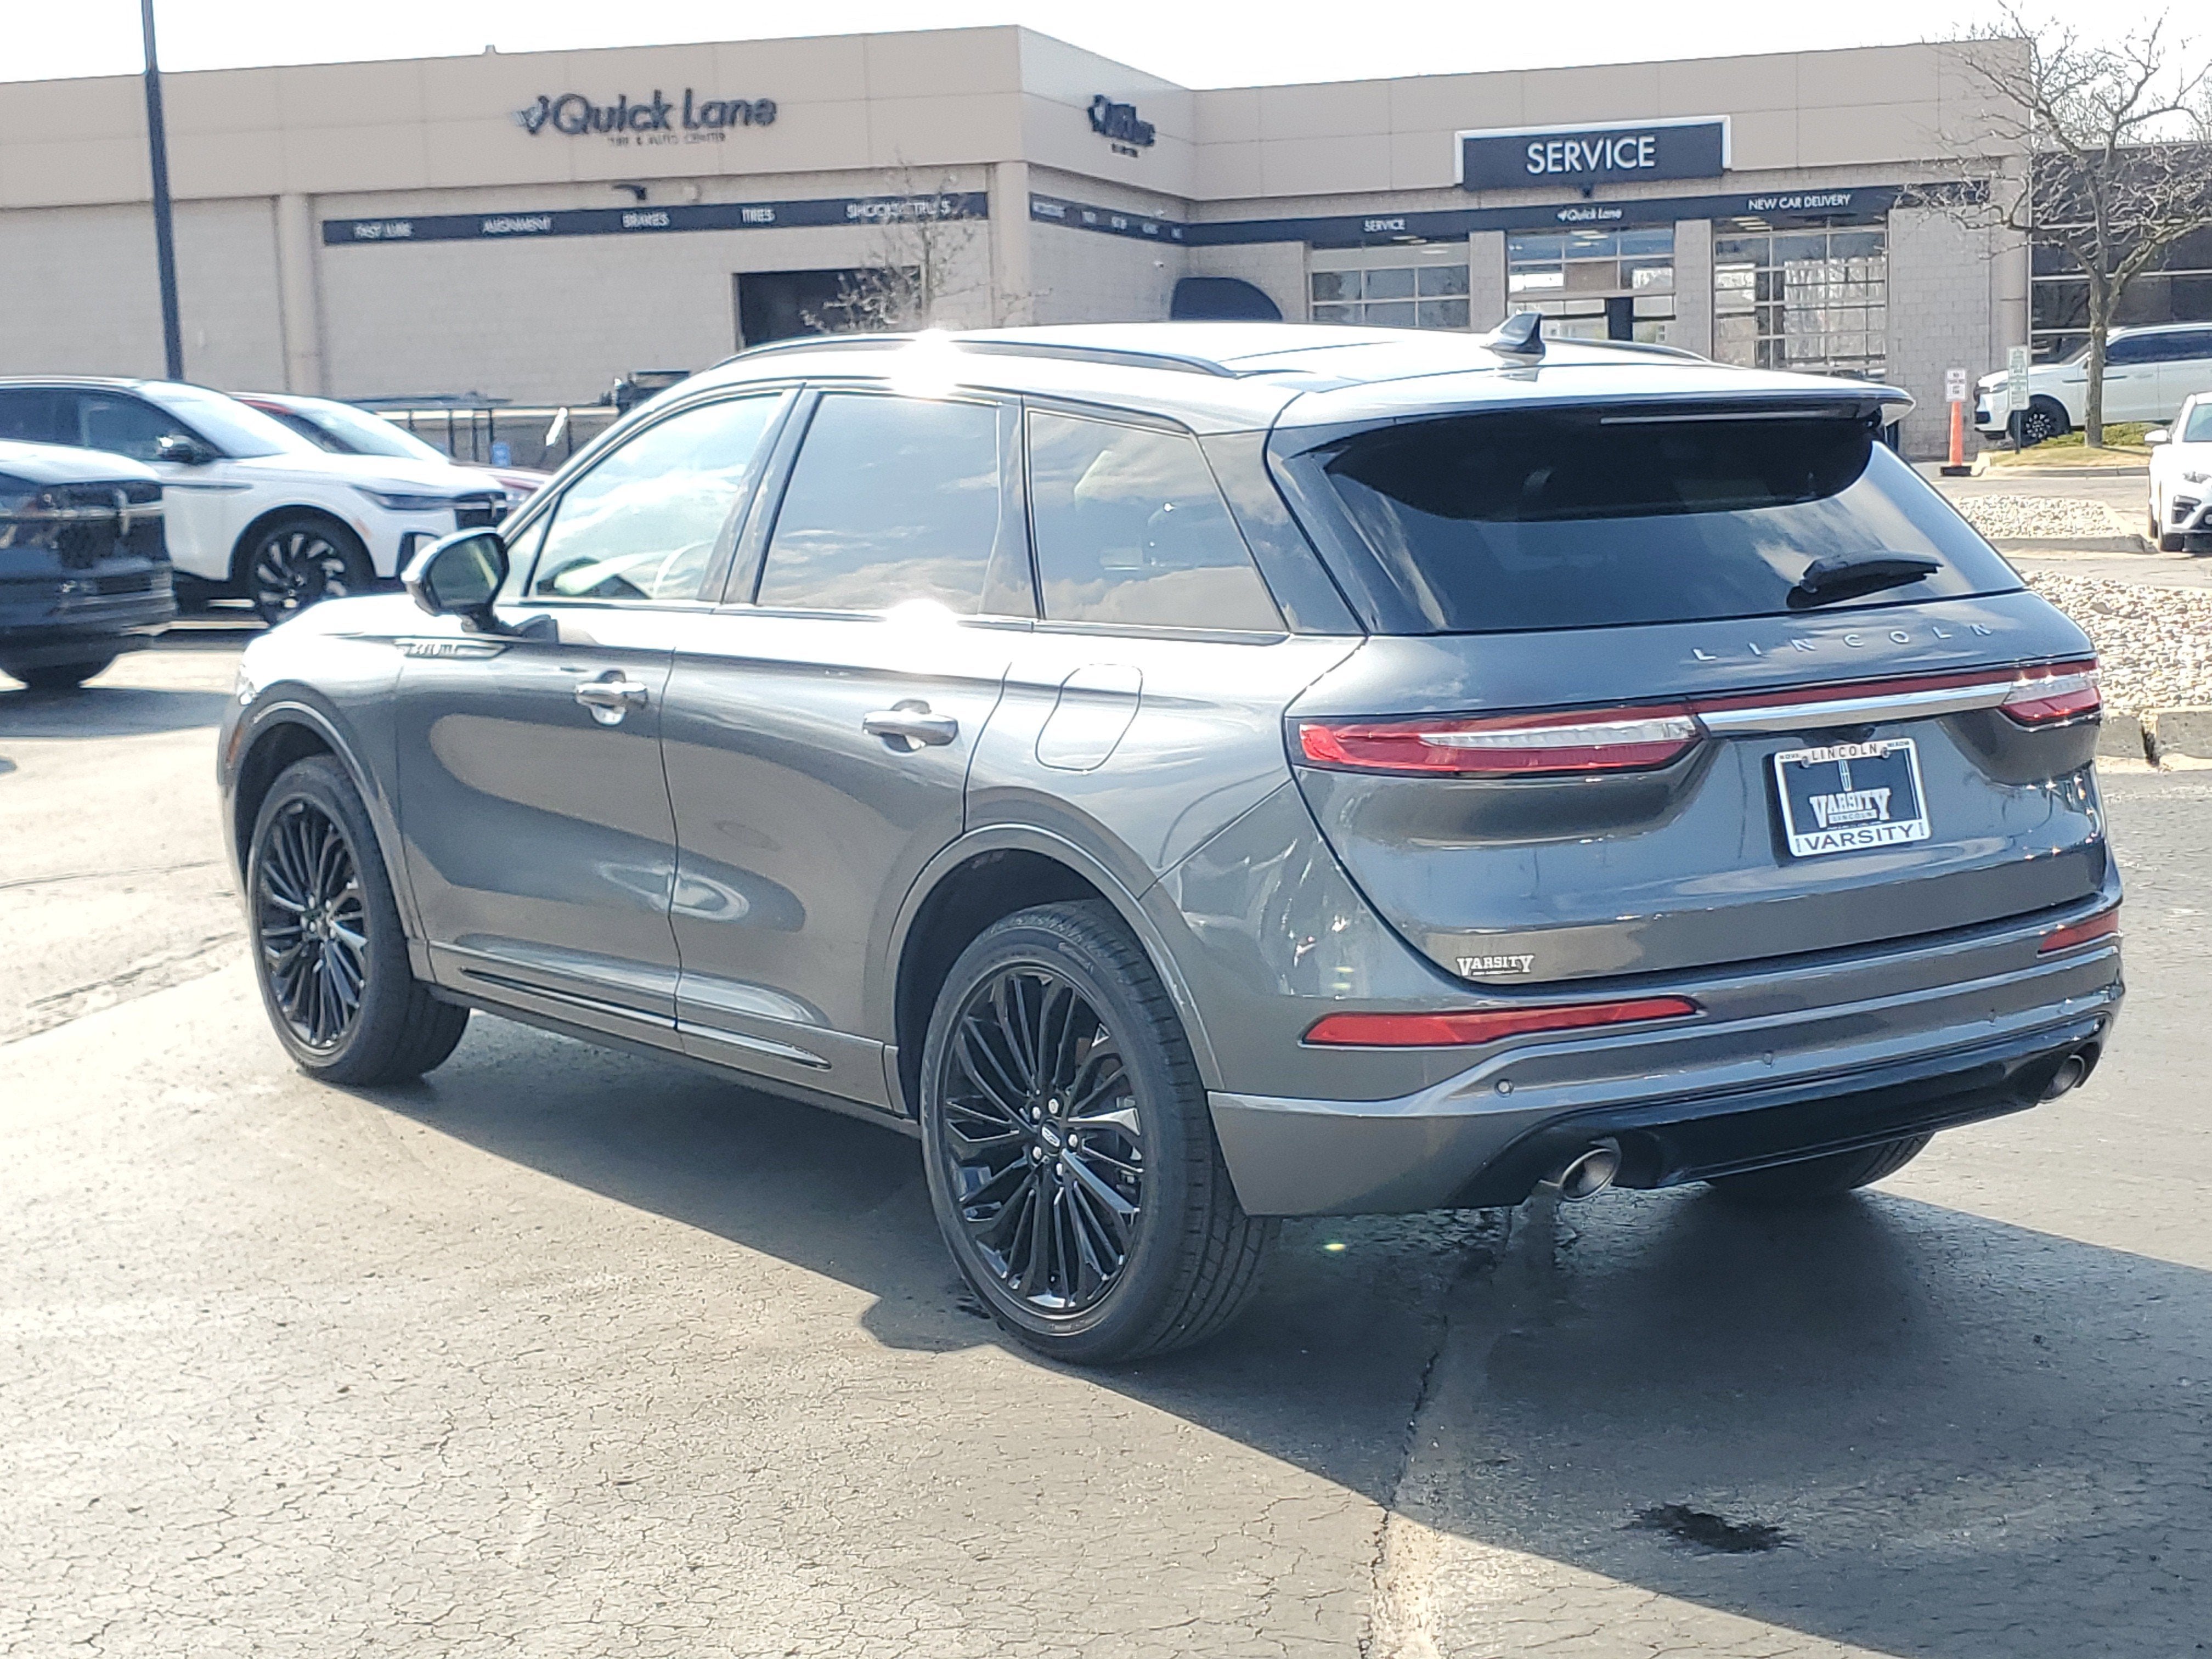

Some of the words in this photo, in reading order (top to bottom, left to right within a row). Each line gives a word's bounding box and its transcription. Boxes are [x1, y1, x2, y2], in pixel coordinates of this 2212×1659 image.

[553, 89, 672, 135] Quick
[684, 87, 777, 131] Lane
[1526, 136, 1656, 174] SERVICE
[1748, 198, 1778, 211] NEW
[1779, 196, 1802, 209] CAR
[1804, 193, 1852, 208] DELIVERY
[623, 212, 670, 228] BRAKES
[1567, 208, 1596, 221] Quick
[1598, 207, 1622, 219] Lane
[1364, 218, 1406, 232] SERVICE
[1692, 623, 1994, 662] LINCOLN
[1812, 743, 1878, 761] LINCOLN
[1809, 788, 1892, 828] VARSITY
[1832, 811, 1872, 822] LINCOLN
[1804, 823, 1914, 850] VARSITY
[1456, 955, 1534, 977] VARSITY
